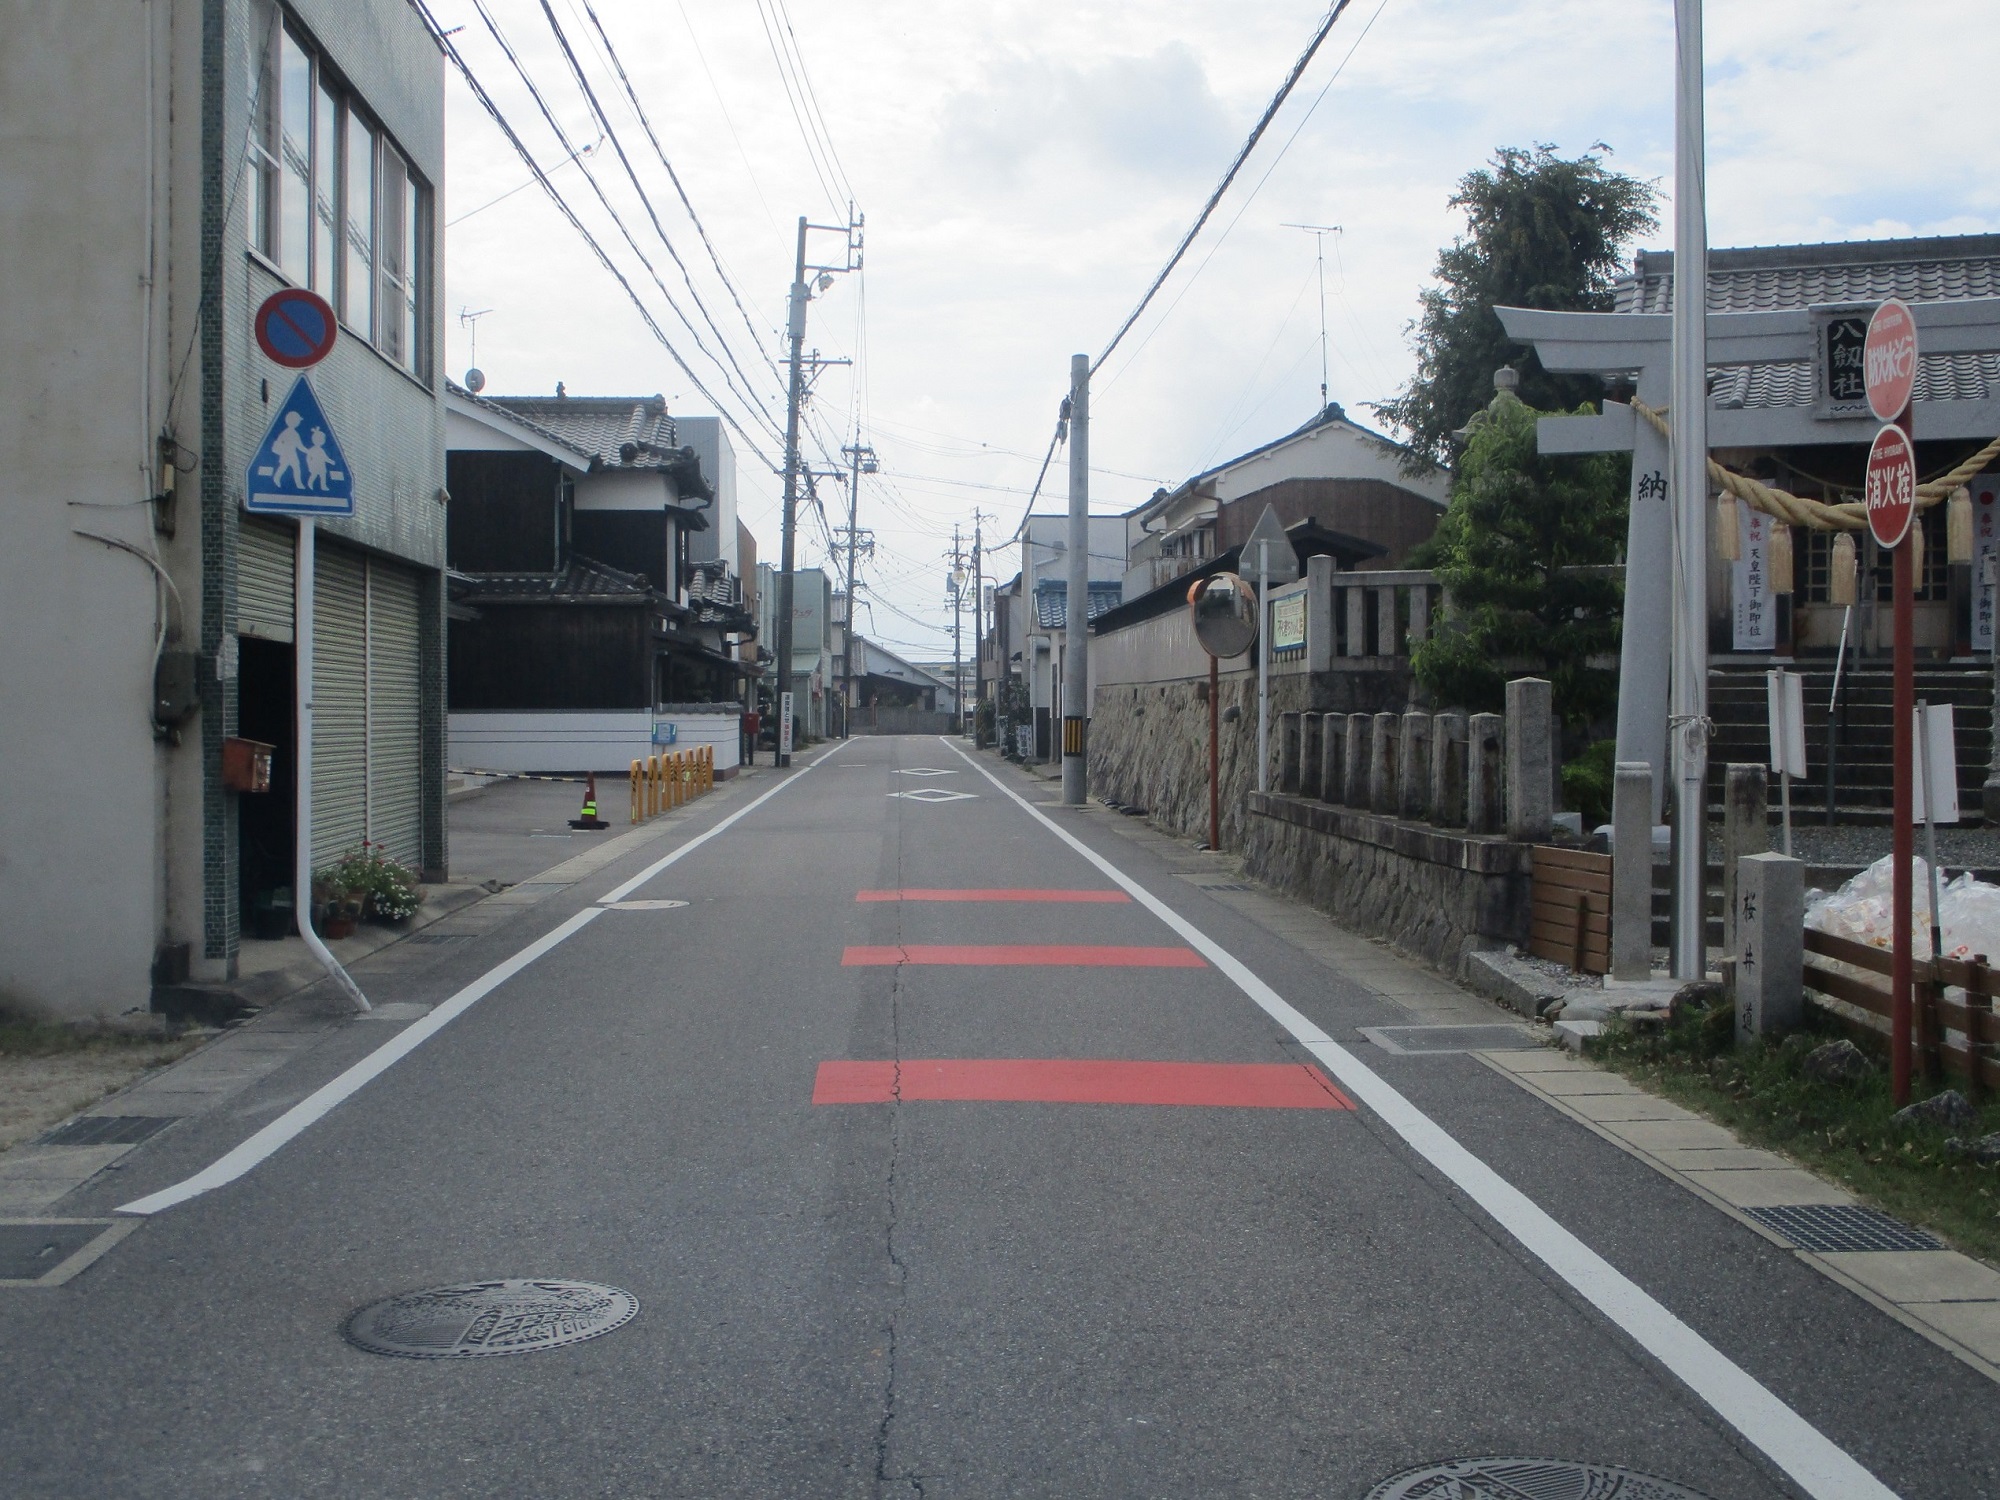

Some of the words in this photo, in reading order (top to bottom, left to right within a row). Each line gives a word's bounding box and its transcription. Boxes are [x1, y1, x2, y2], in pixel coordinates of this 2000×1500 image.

[1867, 335, 1914, 389] 防火水そう
[1872, 448, 1883, 461] FIRE
[1638, 470, 1668, 502] 納
[1868, 461, 1911, 511] 消火栓
[1748, 548, 1762, 637] 天皇陛下御即位
